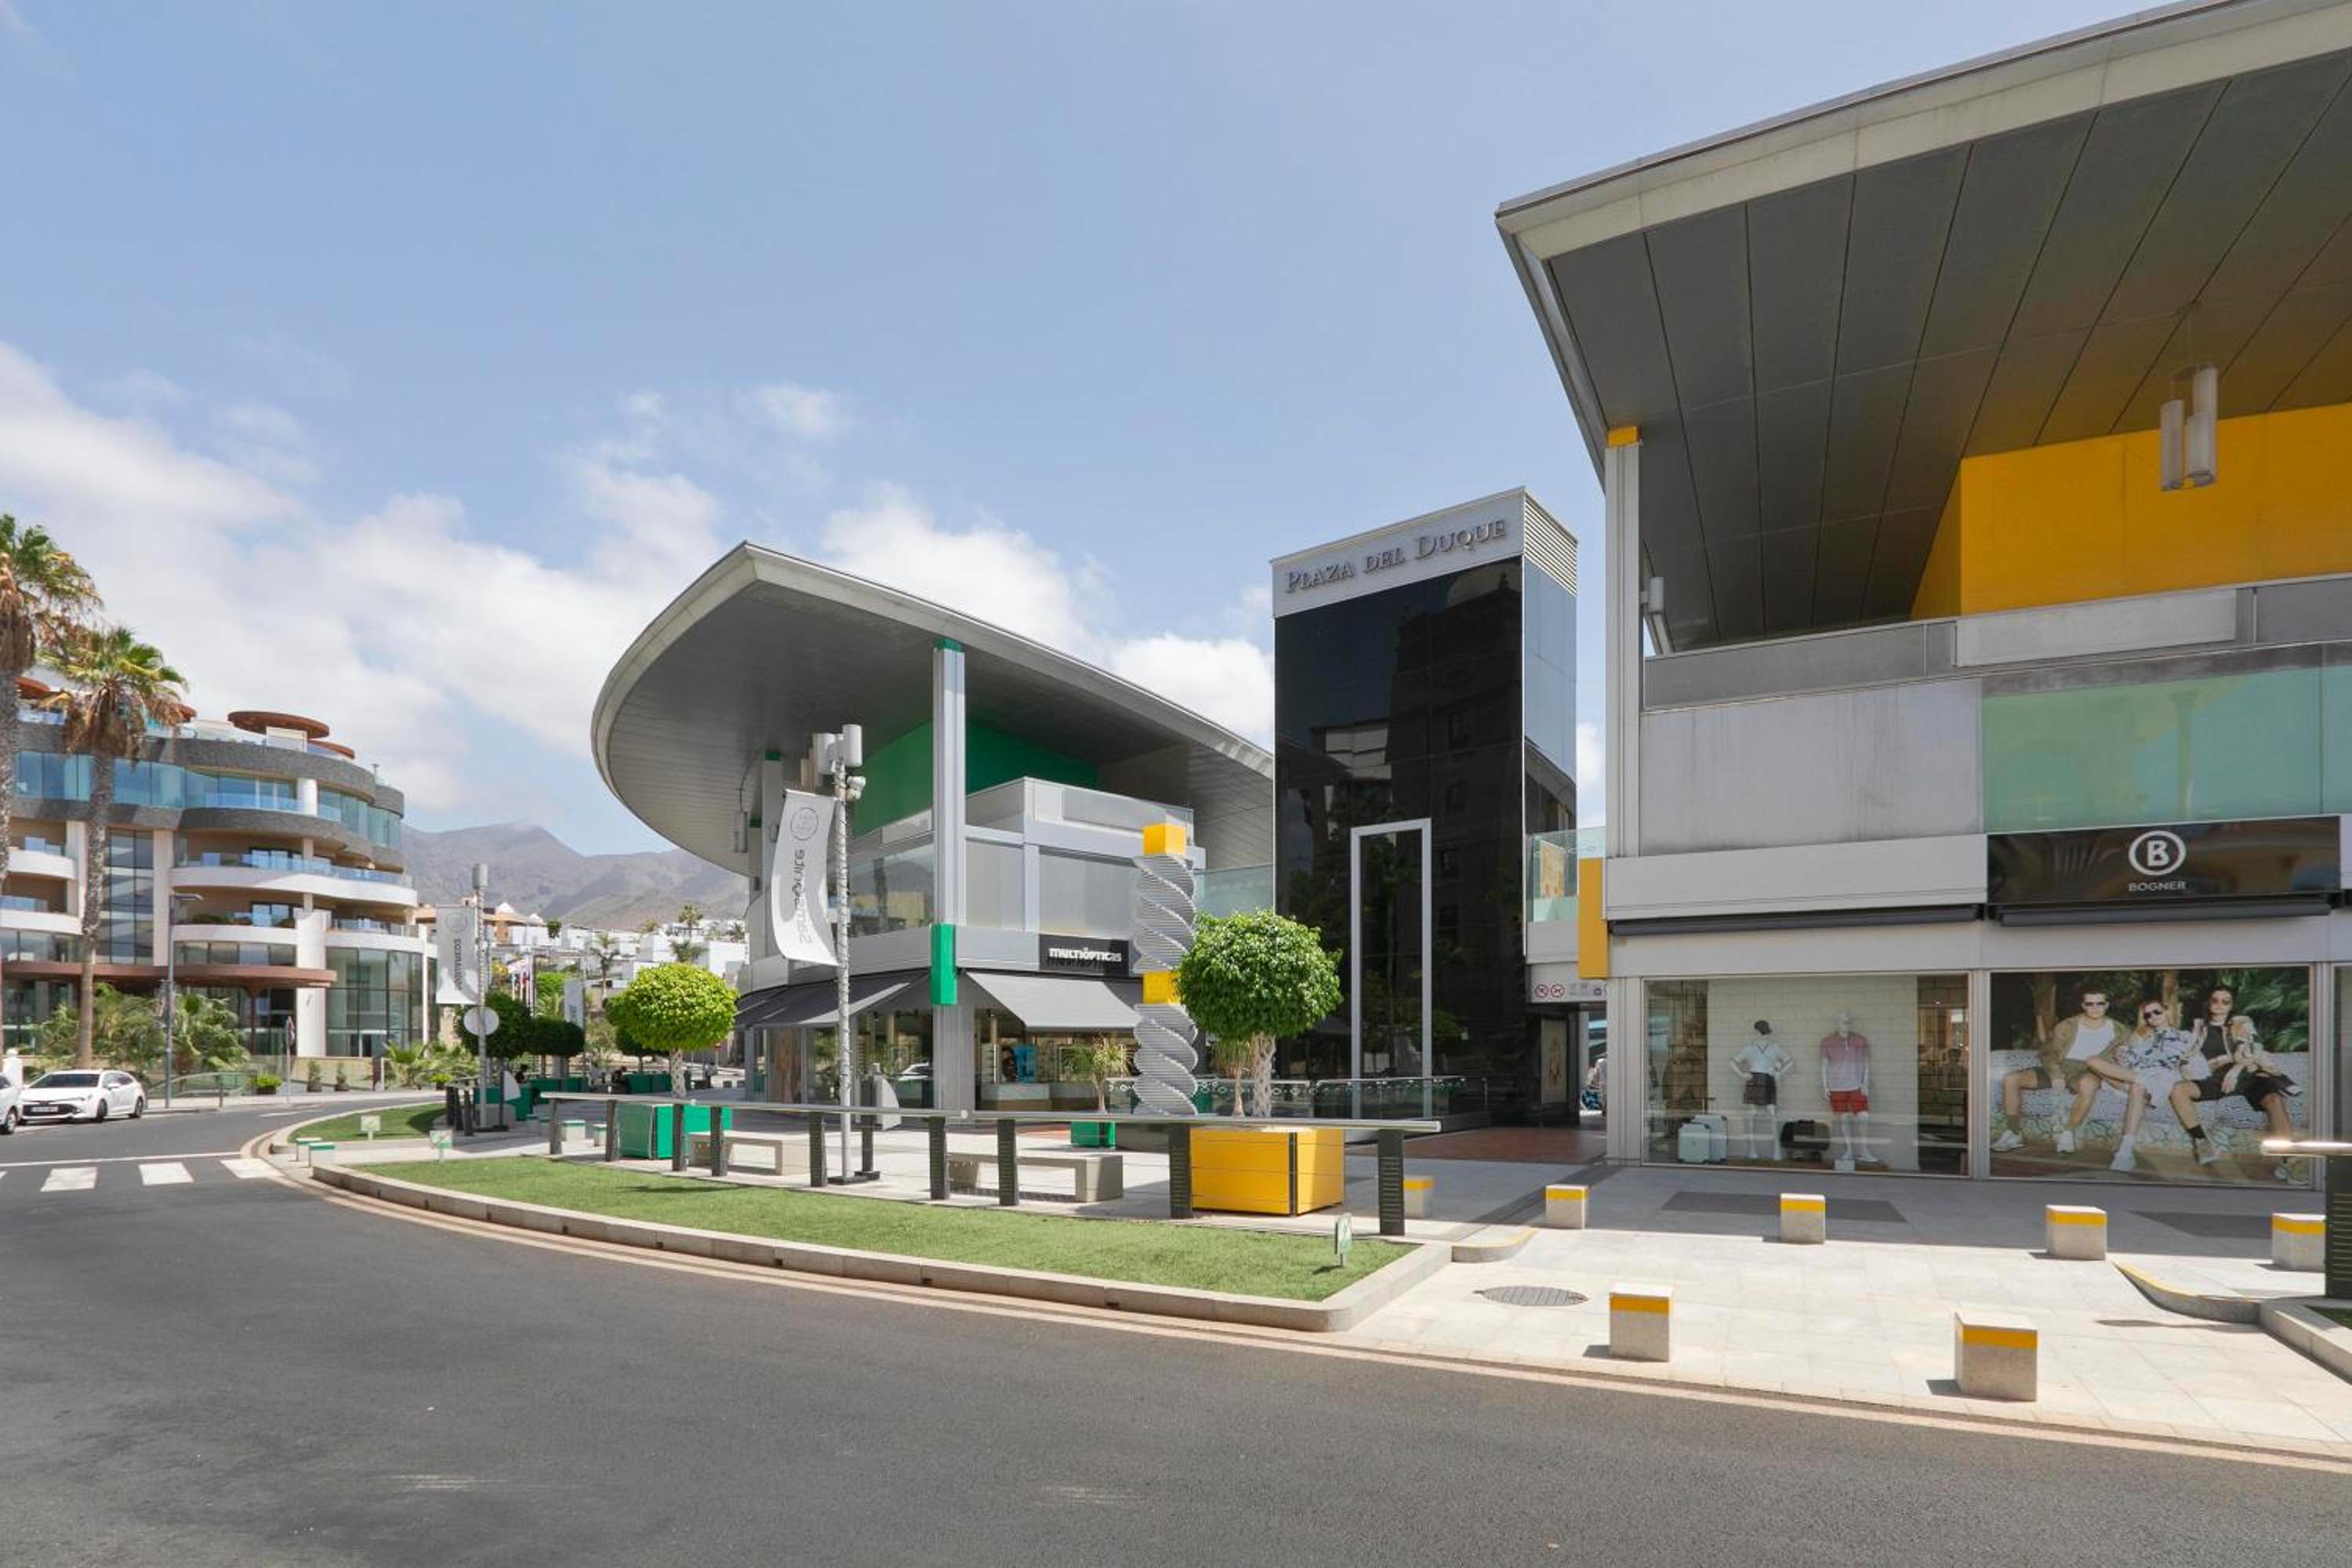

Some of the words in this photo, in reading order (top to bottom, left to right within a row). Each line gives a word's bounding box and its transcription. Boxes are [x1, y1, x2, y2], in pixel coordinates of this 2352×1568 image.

[1285, 562, 1356, 593] PLAZA
[1363, 547, 1406, 574] DEL
[1414, 519, 1507, 560] DUQUE
[2147, 840, 2169, 866] B
[2128, 880, 2187, 891] BOGNER
